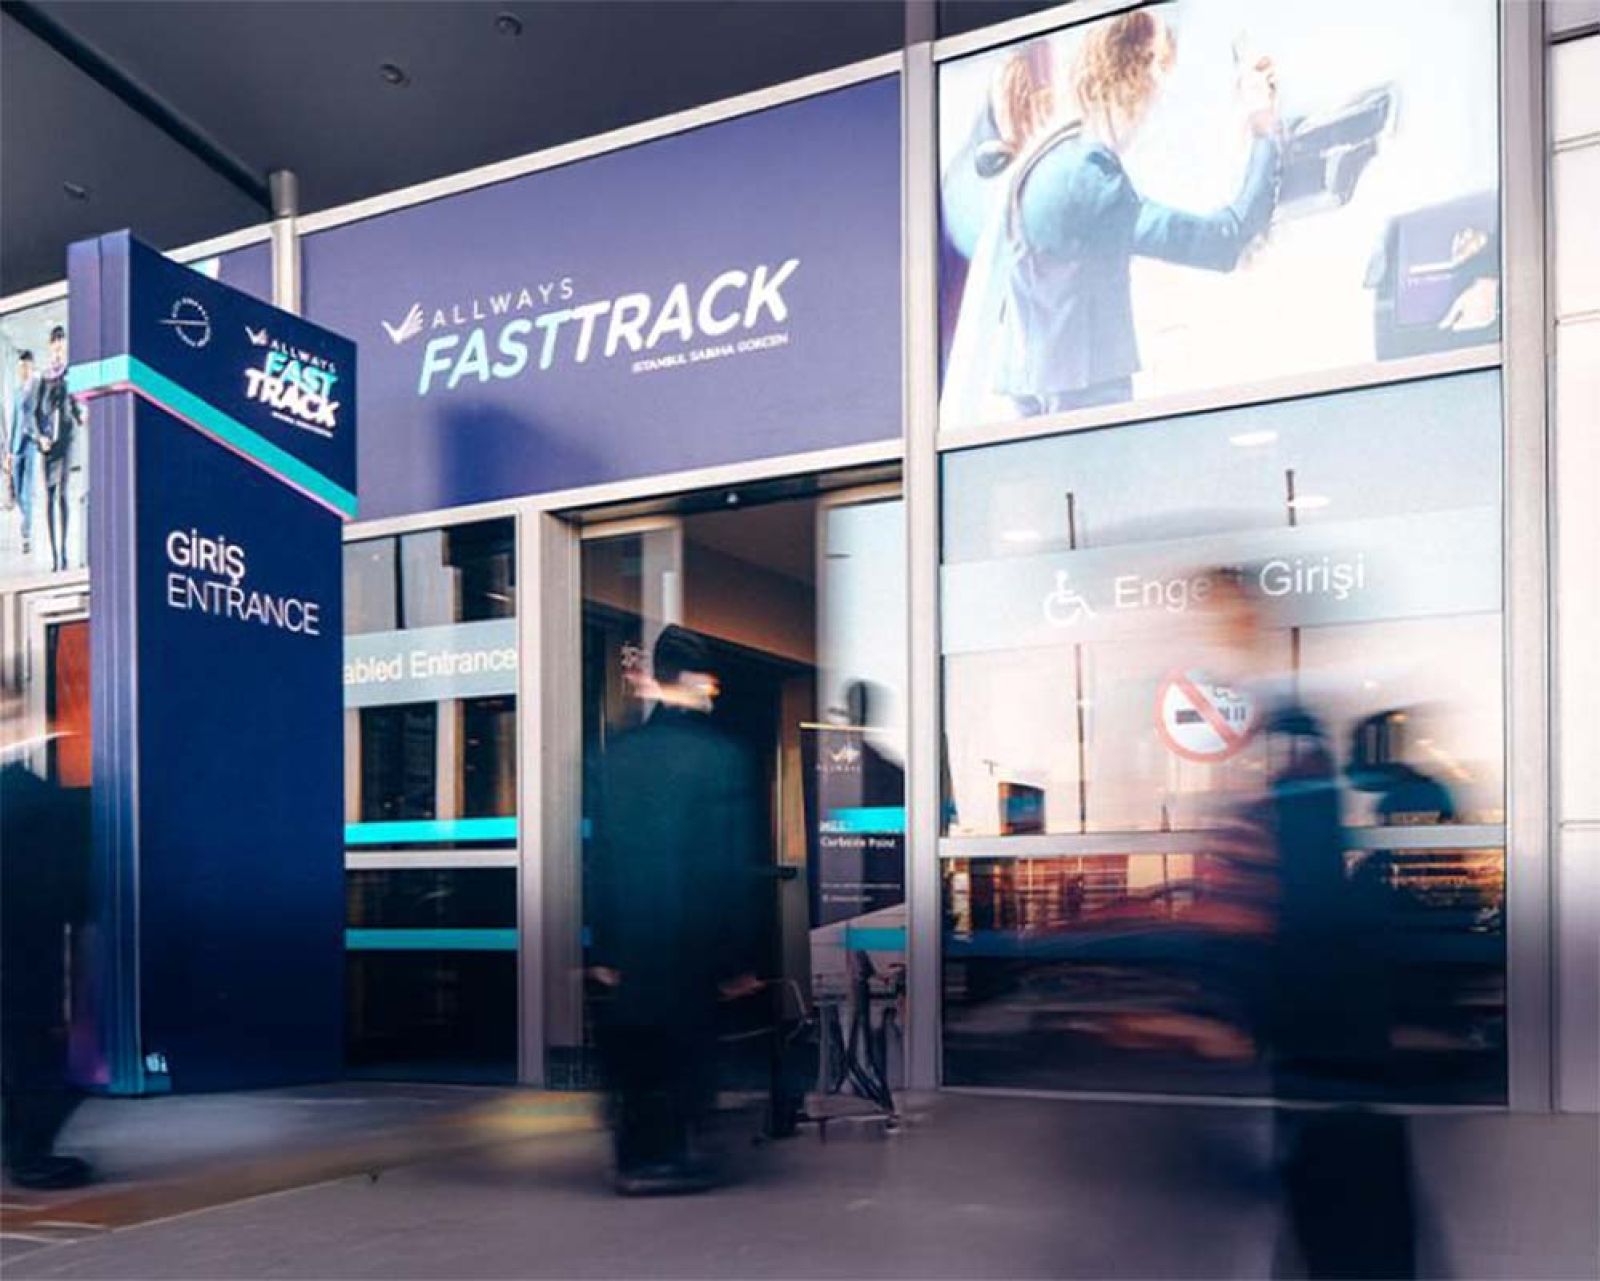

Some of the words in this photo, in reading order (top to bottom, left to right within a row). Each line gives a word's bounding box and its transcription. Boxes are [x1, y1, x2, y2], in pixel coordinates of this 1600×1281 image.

[432, 277, 574, 329] ALLWAYS
[244, 367, 341, 427] TRACK
[265, 351, 339, 401] FAST
[1258, 552, 1365, 601] Girişi
[167, 572, 321, 637] ENTRANCE
[411, 646, 517, 679] Entrance
